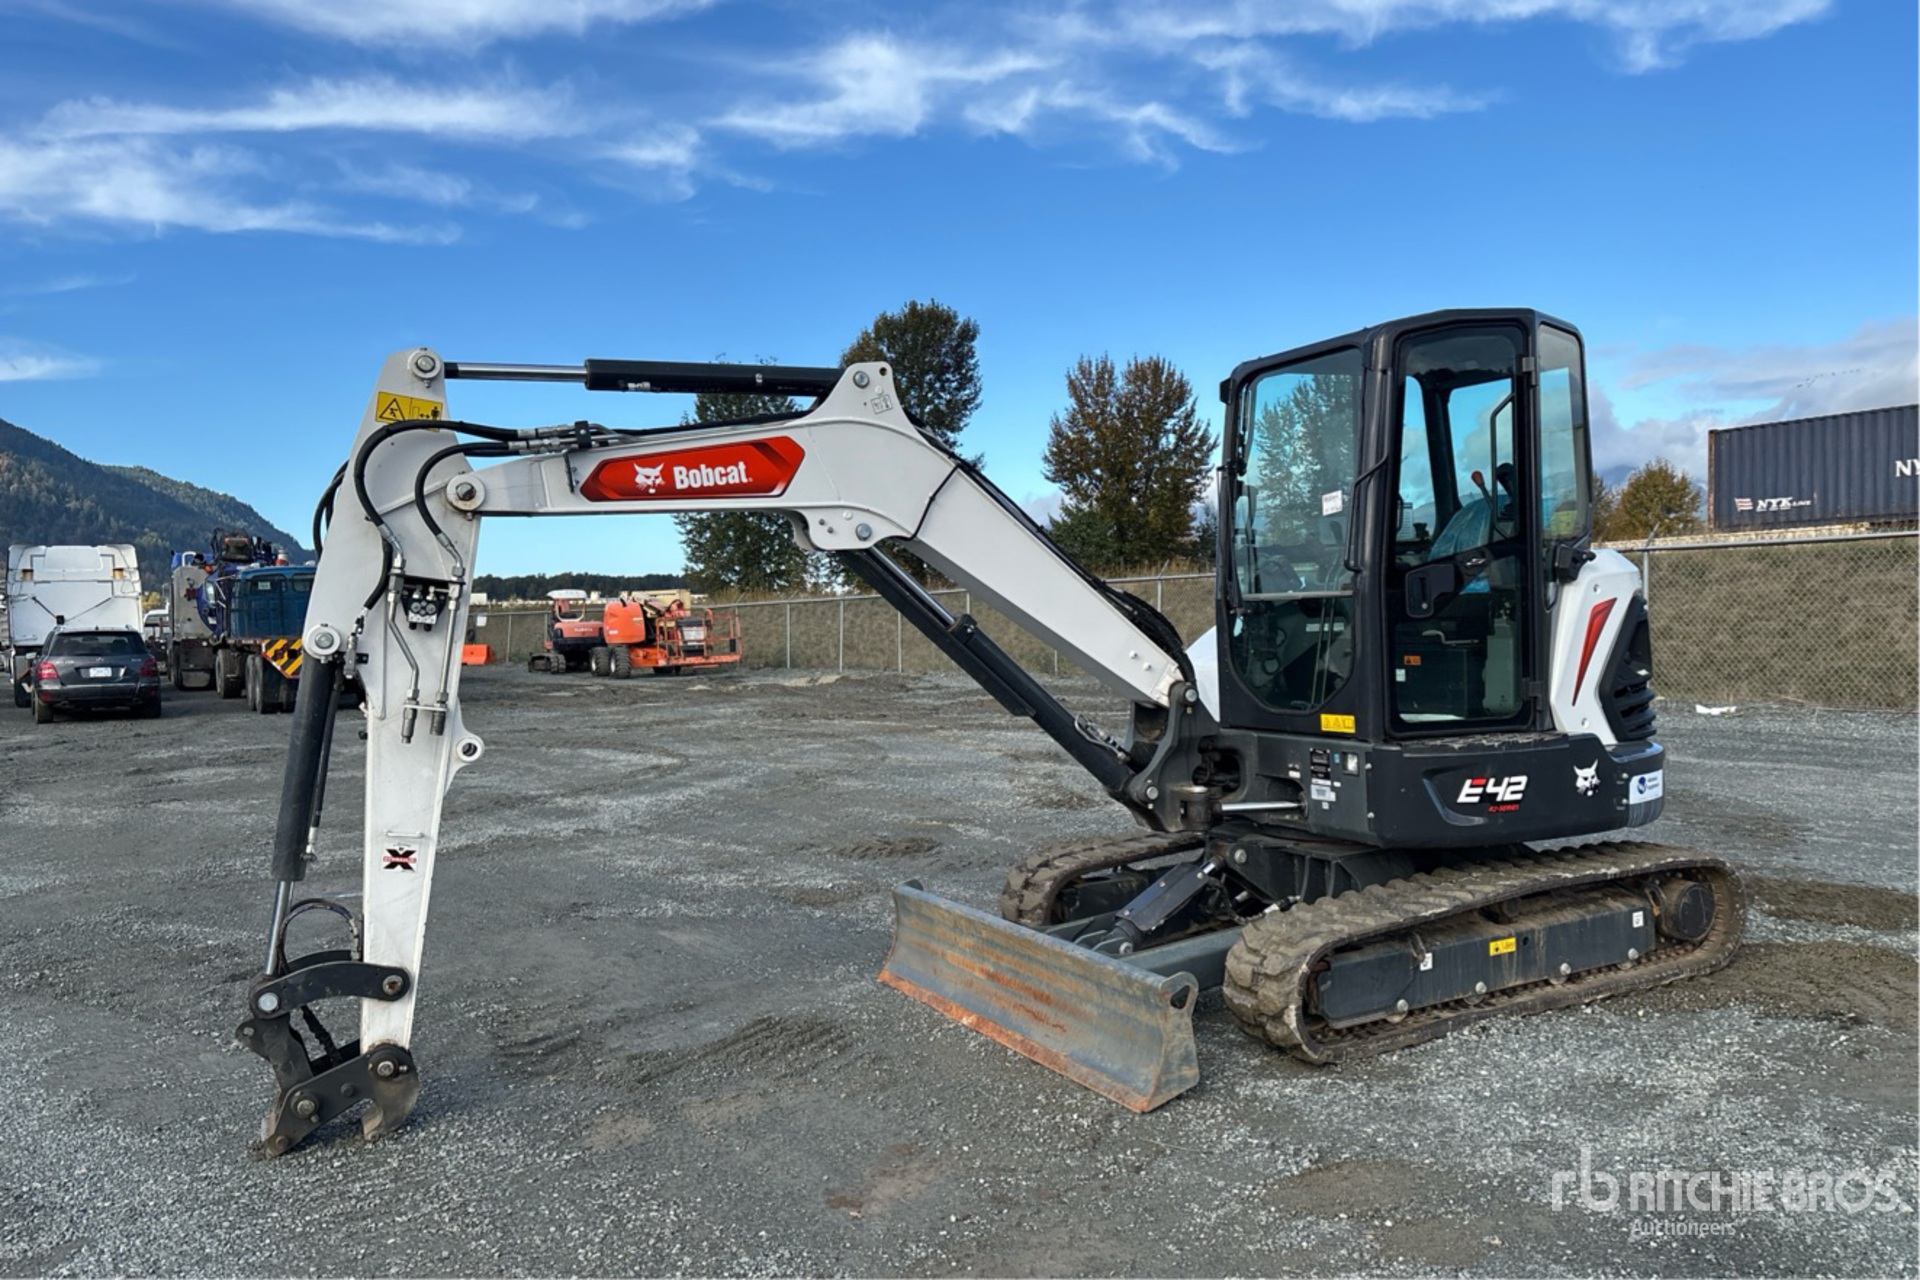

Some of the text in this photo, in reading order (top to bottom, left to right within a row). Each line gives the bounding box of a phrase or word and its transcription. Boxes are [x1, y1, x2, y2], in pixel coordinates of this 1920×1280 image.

[673, 461, 748, 489] Bobcat
[1756, 497, 1793, 512] NYK
[1456, 775, 1528, 803] E42
